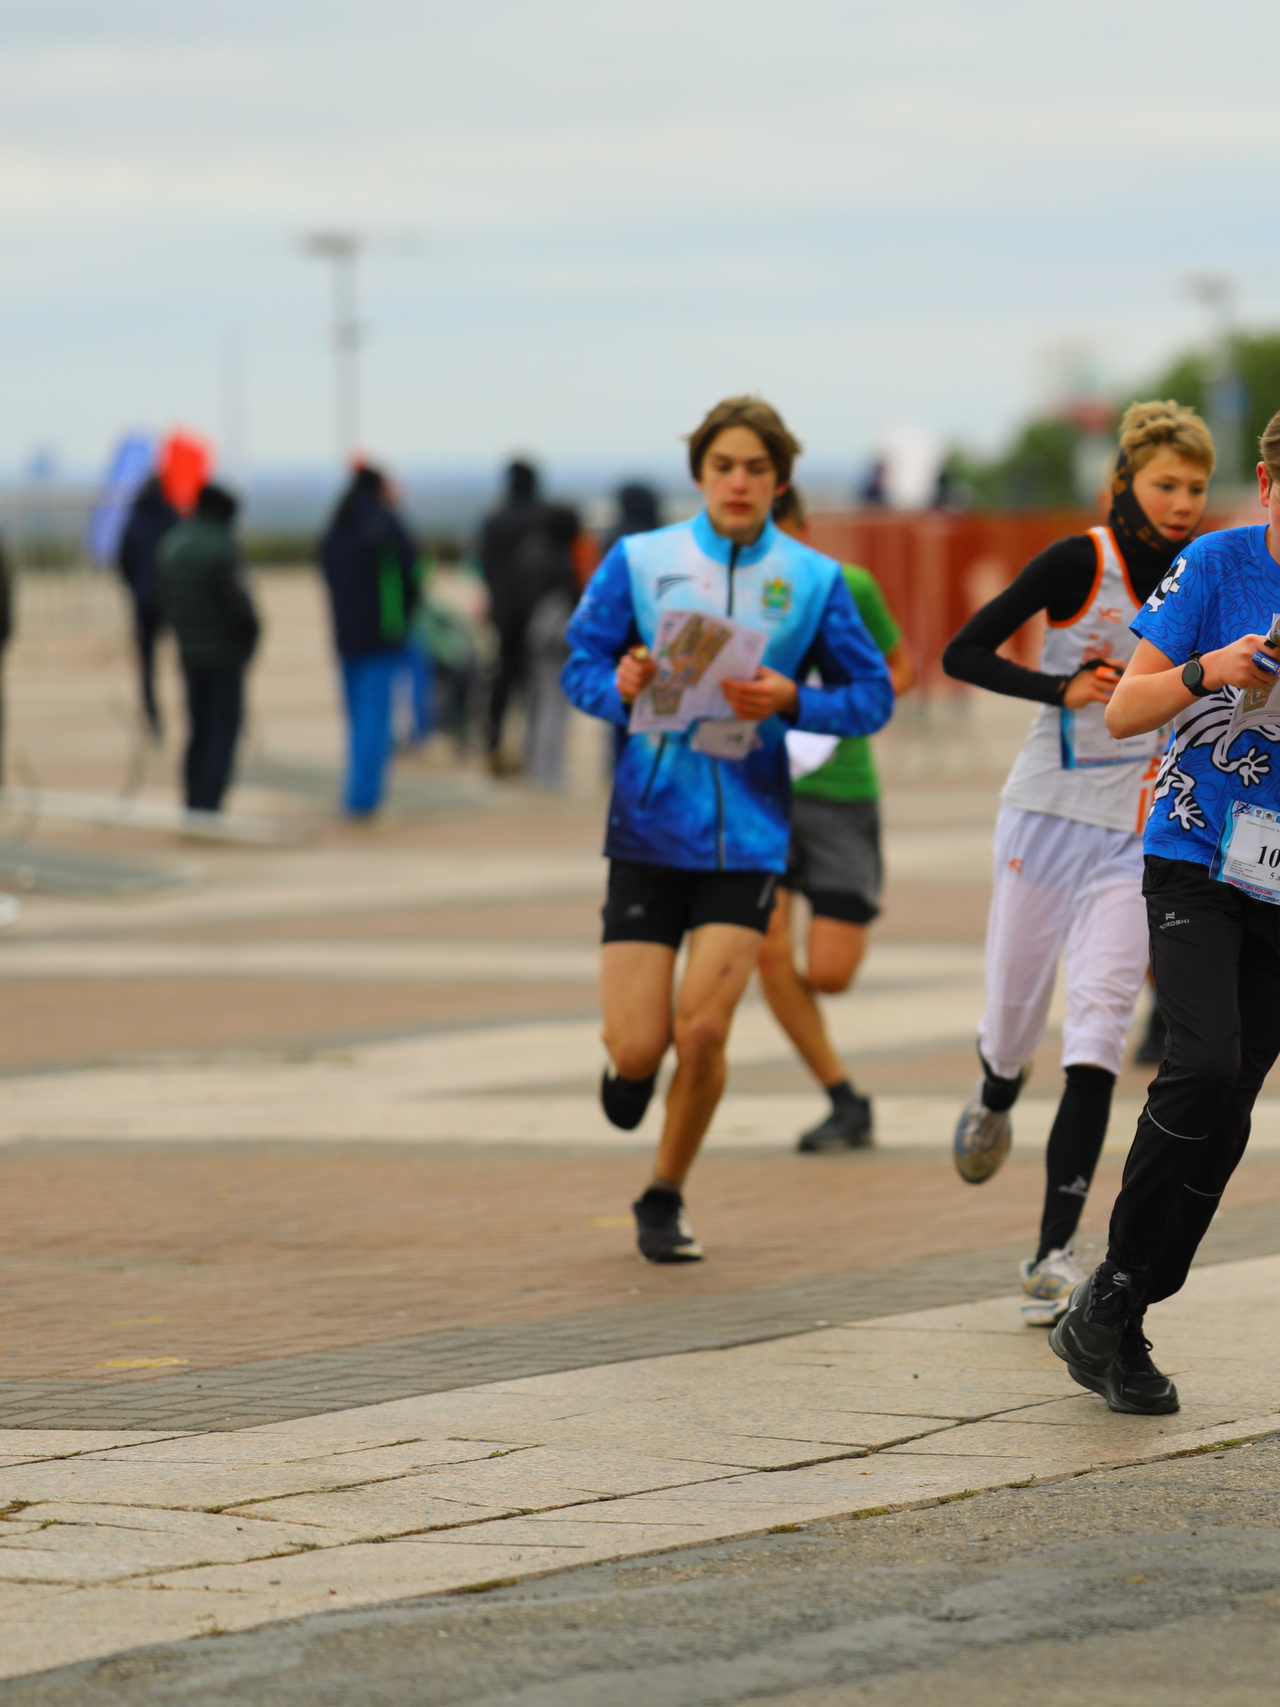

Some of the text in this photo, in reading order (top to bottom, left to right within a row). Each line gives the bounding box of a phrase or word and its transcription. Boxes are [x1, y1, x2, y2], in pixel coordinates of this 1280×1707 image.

[1269, 872, 1275, 880] 5
[1224, 876, 1273, 896] ПЕРВЕНСТВО РОССИИ
